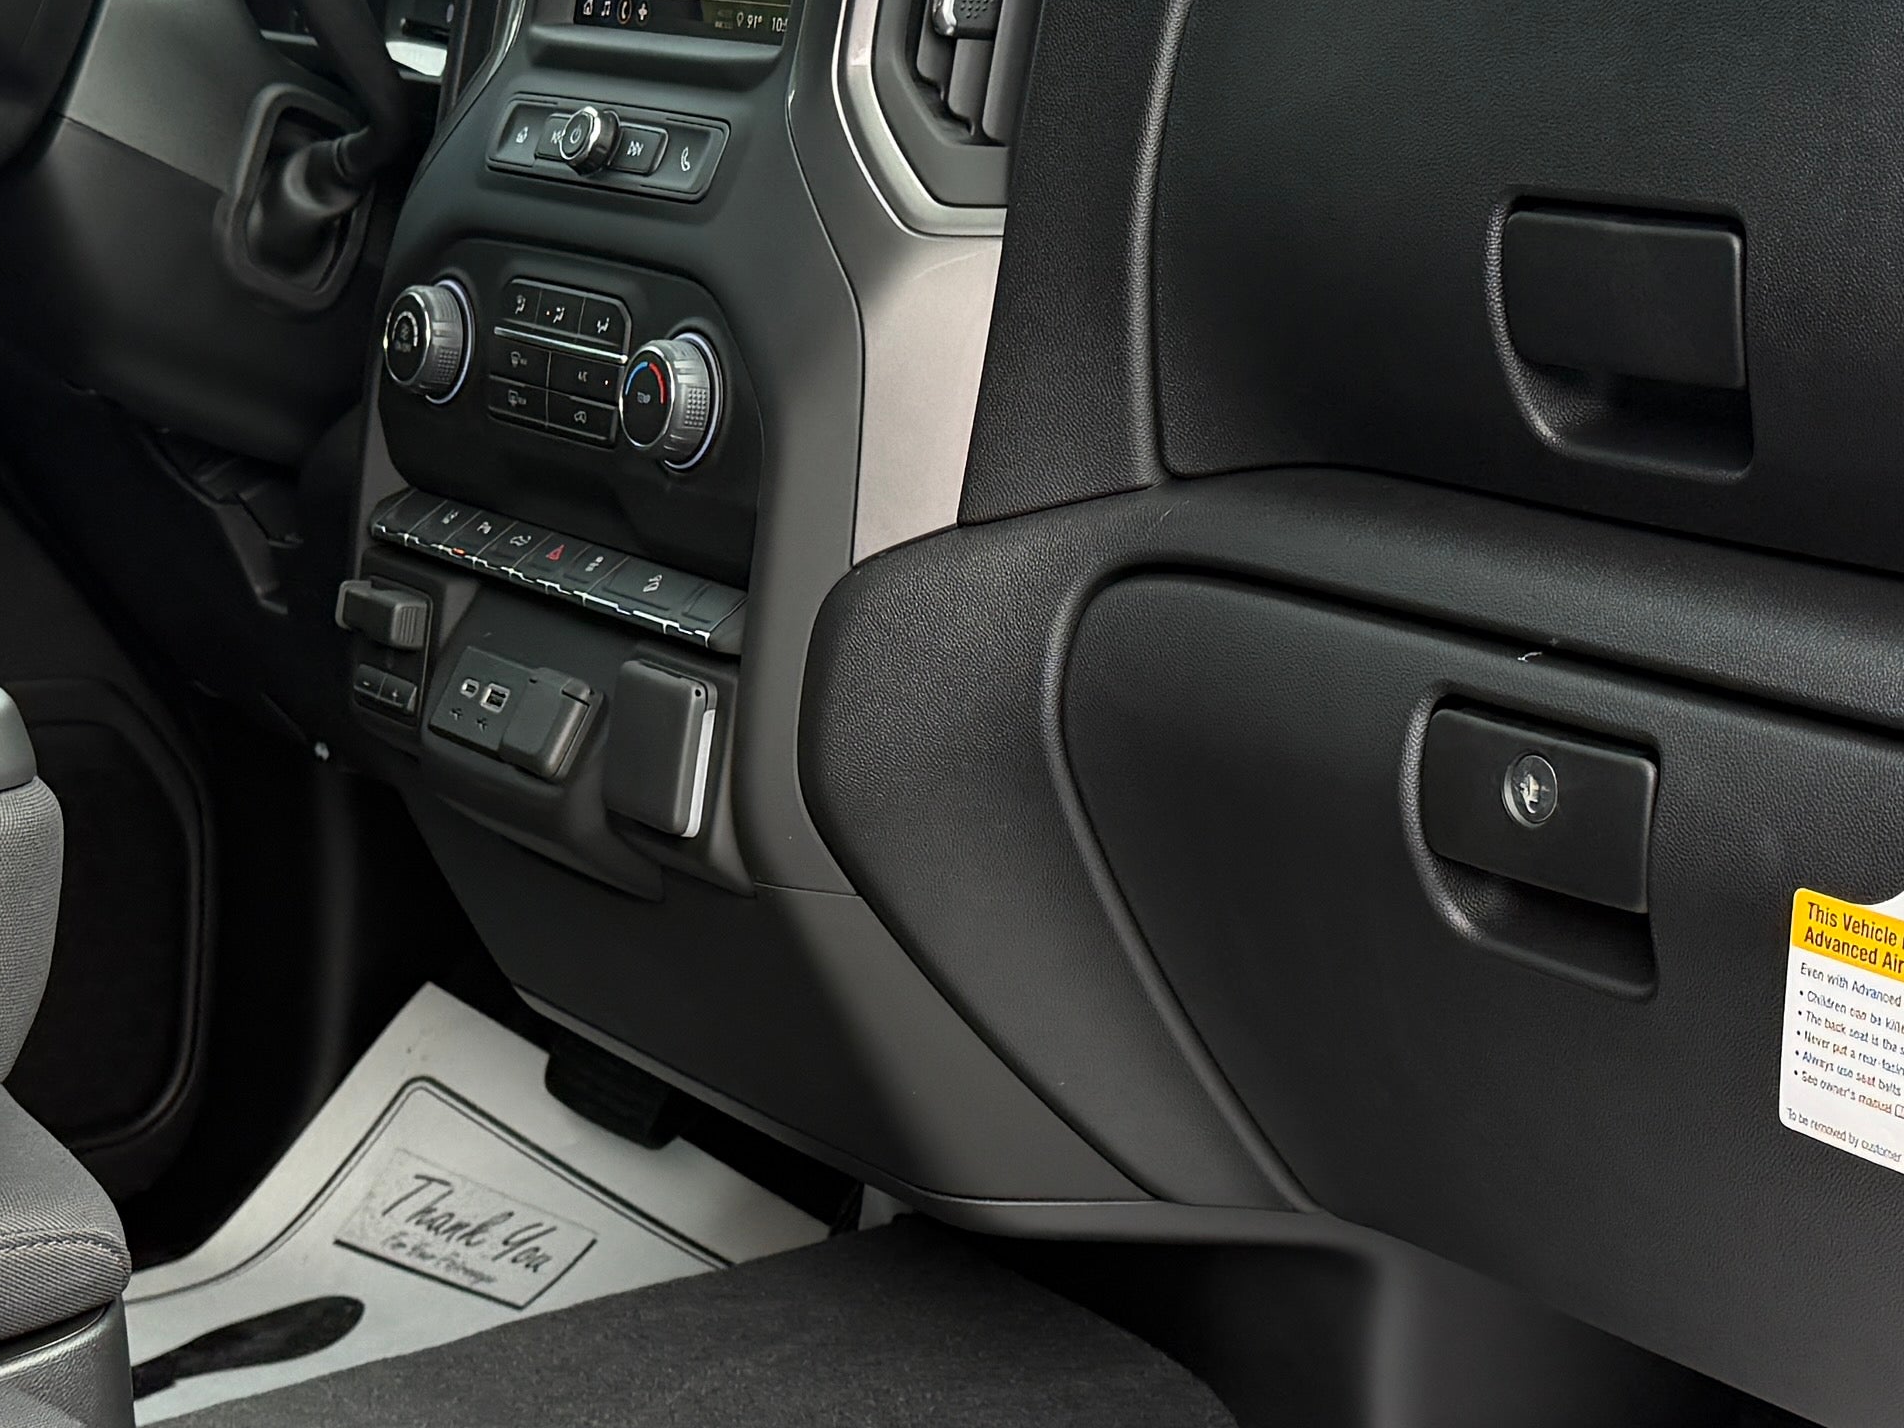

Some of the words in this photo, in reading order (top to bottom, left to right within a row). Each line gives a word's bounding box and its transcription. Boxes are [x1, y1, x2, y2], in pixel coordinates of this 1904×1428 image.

[1807, 902, 1838, 928] This
[1843, 913, 1897, 947] Vehicle
[1804, 926, 1878, 965] Advanced
[1882, 952, 1904, 974] Air
[1800, 962, 1824, 982] Even
[1827, 974, 1848, 991] with
[1852, 981, 1901, 1008] Advanced
[1807, 990, 1847, 1014] Children
[1850, 1007, 1867, 1020] can
[1870, 1013, 1882, 1026] be
[1804, 1031, 1831, 1050] Never
[1806, 1010, 1822, 1026] The
[1824, 1018, 1846, 1035] back
[1882, 1038, 1897, 1053] the
[1802, 1051, 1834, 1072] Always
[1856, 1072, 1876, 1088] seat
[1786, 1107, 1797, 1122] To
[1848, 1131, 1859, 1148] by
[381, 1174, 515, 1247] Thank
[492, 1222, 558, 1273] You
